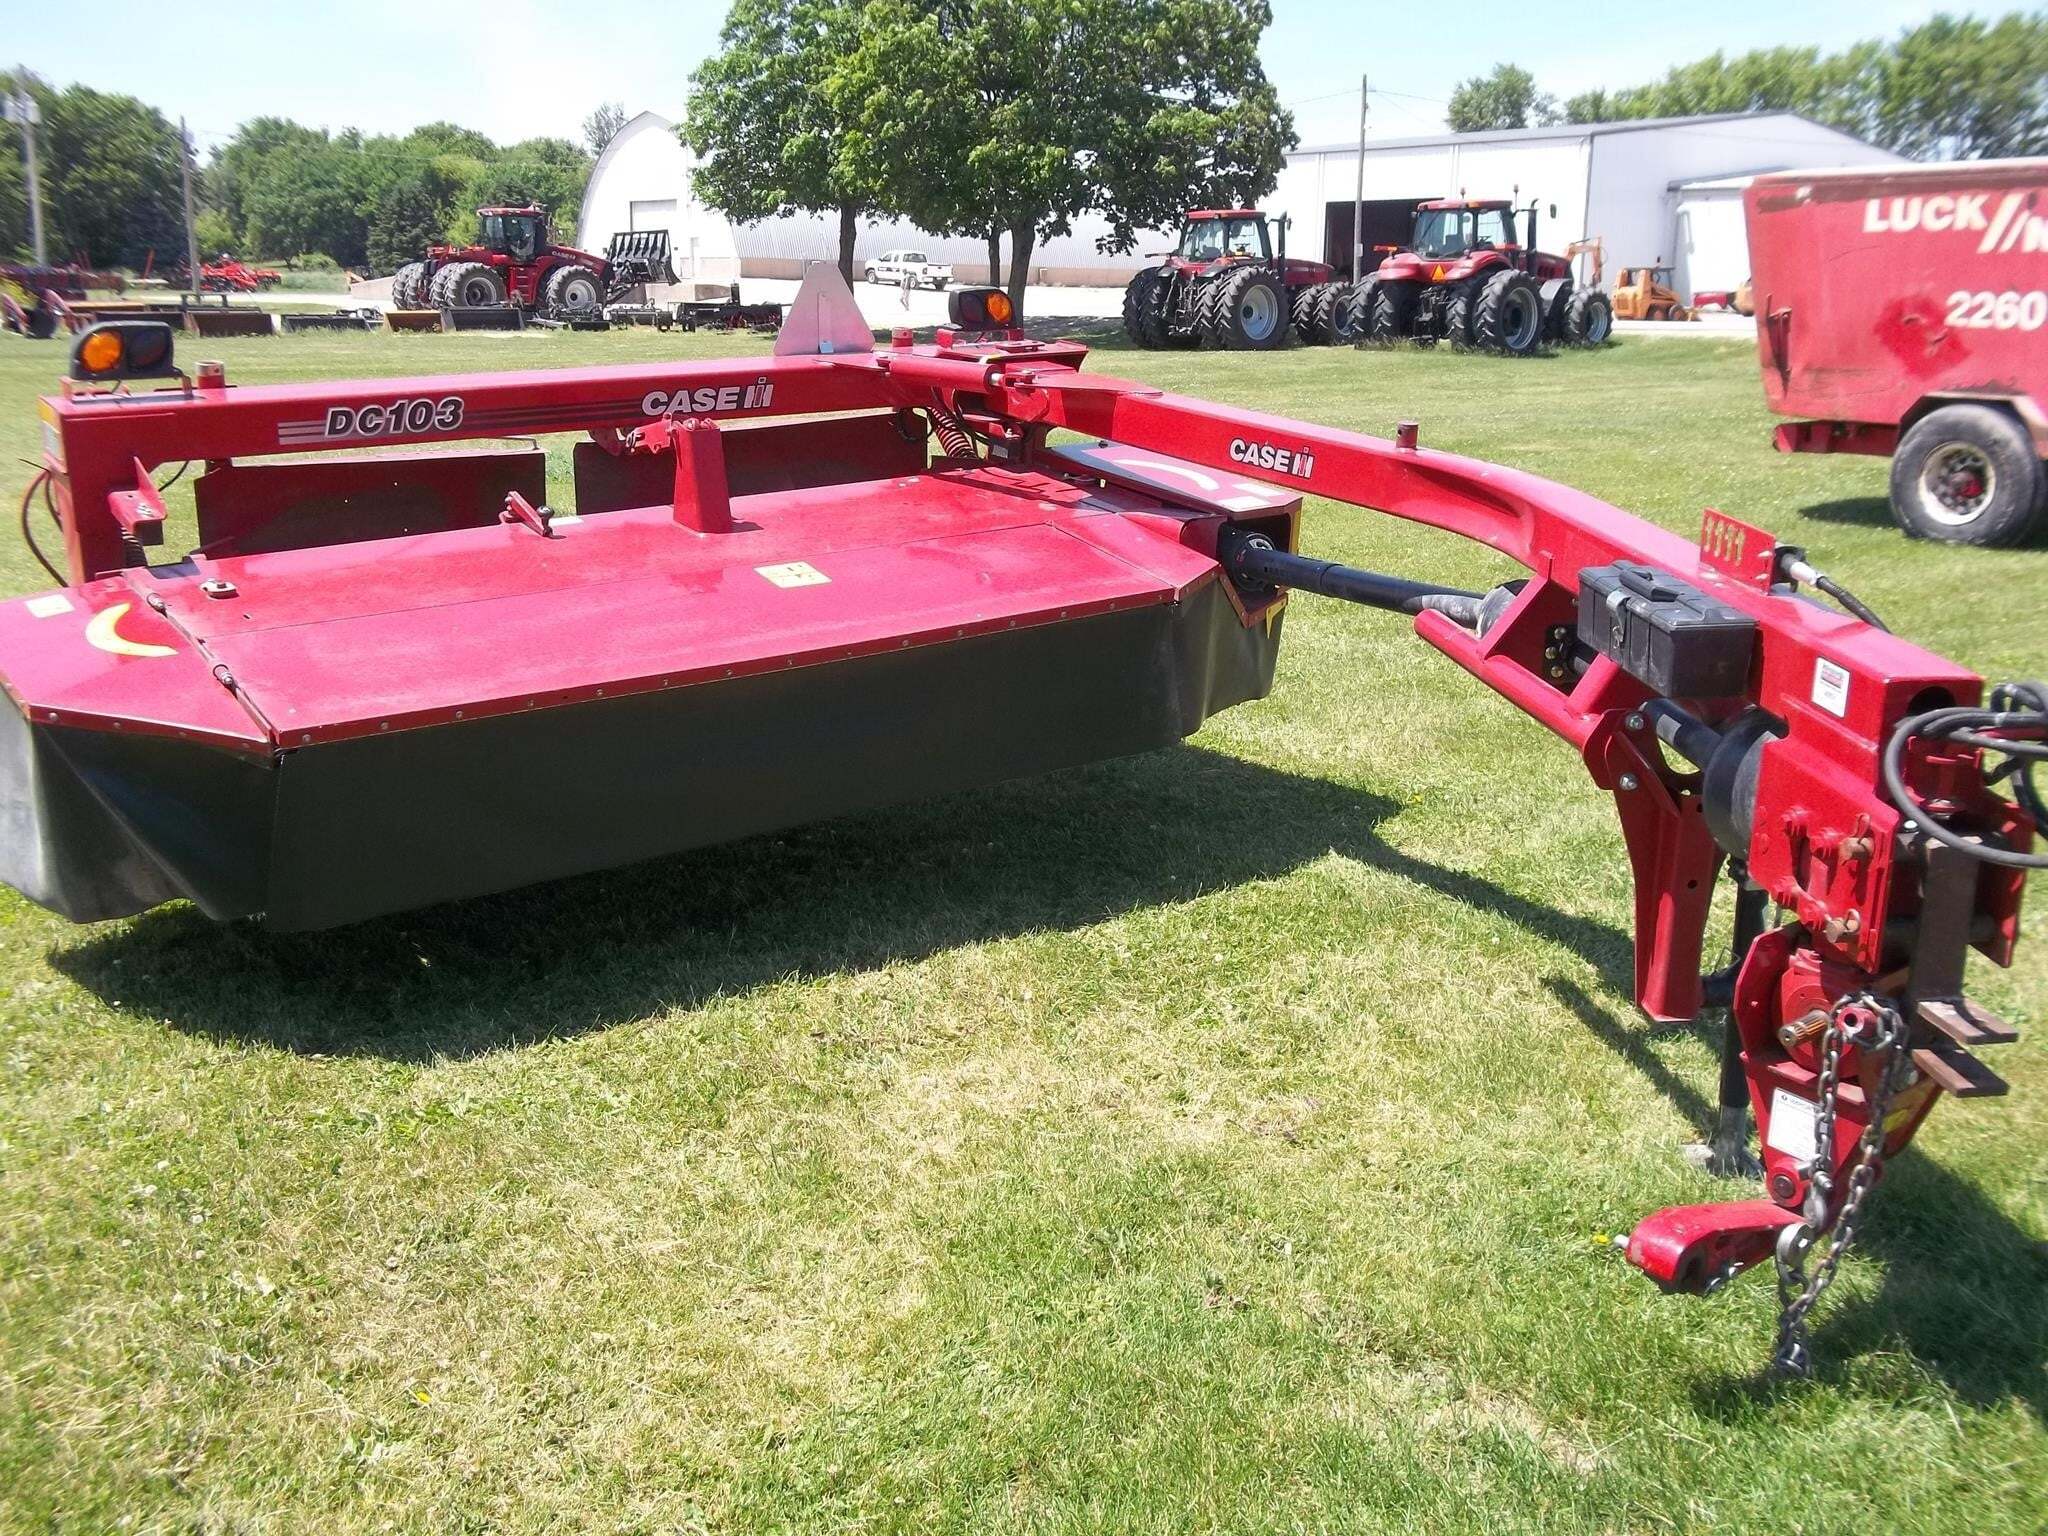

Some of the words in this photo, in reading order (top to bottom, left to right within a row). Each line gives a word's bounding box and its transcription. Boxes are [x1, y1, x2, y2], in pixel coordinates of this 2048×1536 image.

[1945, 290, 2048, 331] 2260
[325, 396, 465, 438] DC103
[641, 386, 740, 416] CASE
[1229, 439, 1291, 473] CASE
